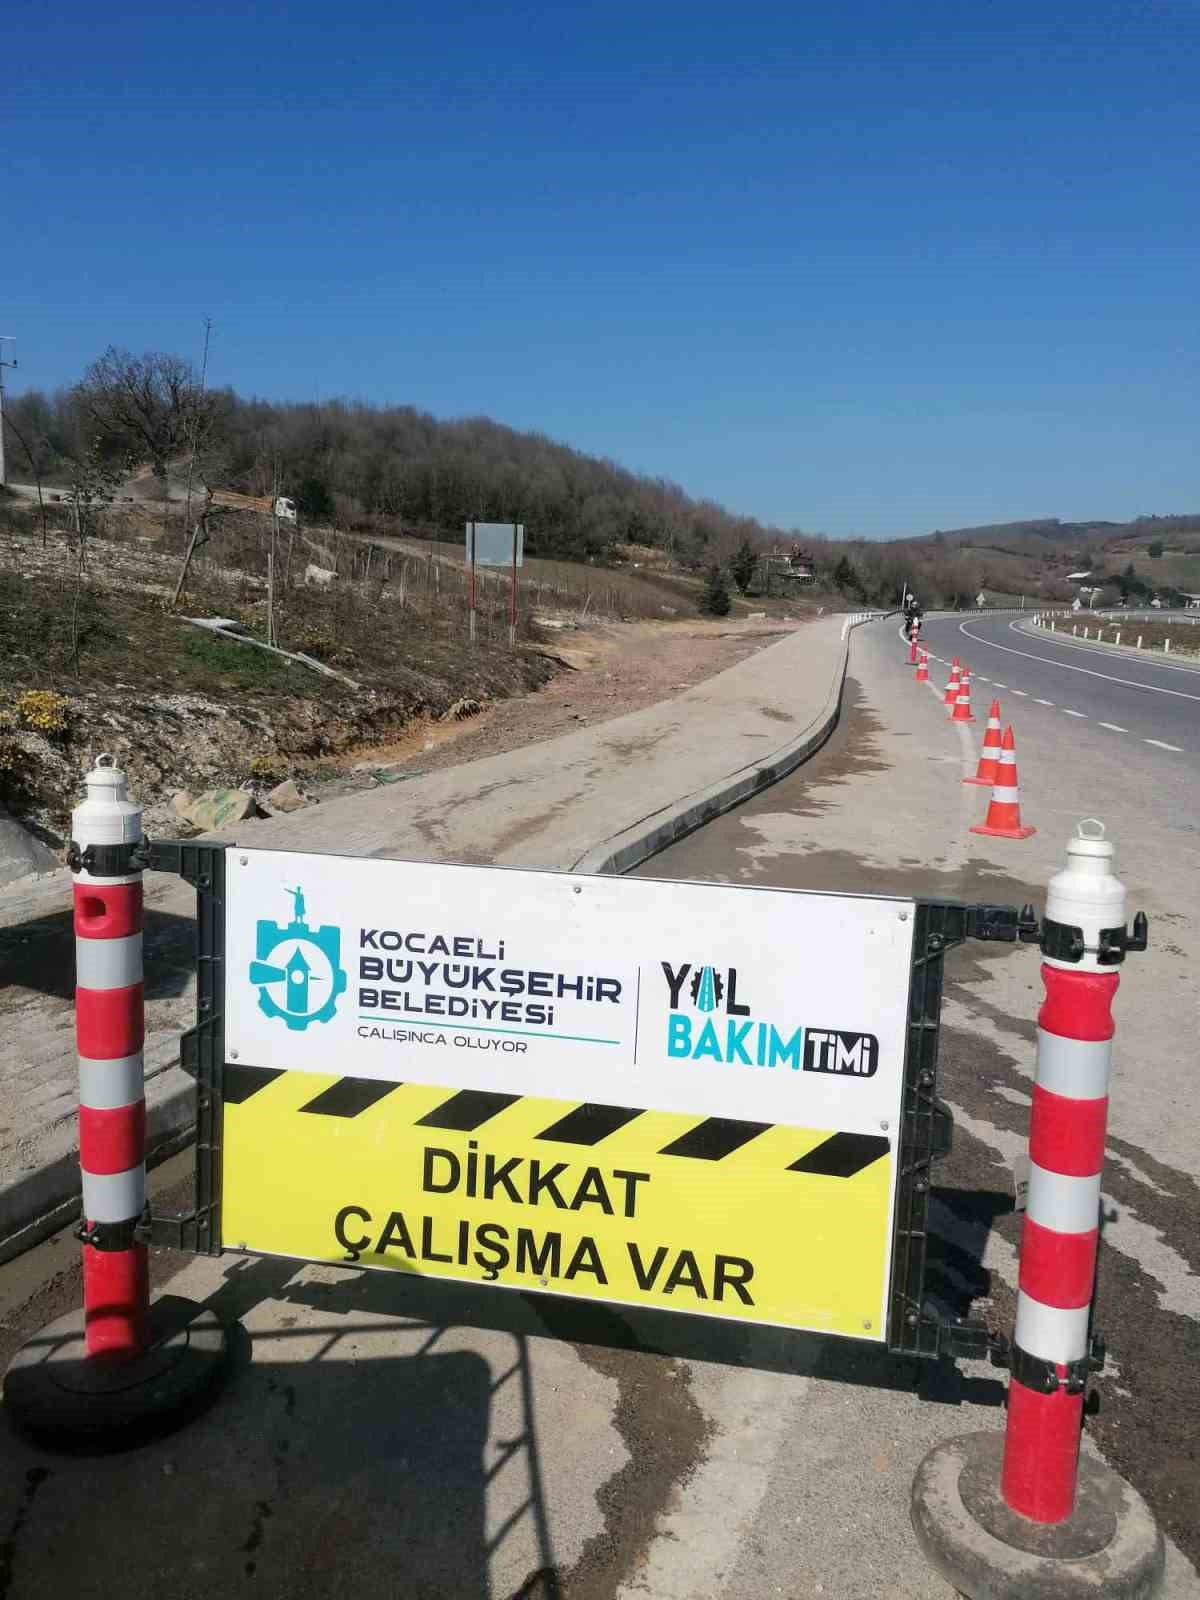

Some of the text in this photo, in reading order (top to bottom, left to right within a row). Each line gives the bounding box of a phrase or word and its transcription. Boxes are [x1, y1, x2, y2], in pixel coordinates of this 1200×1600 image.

[454, 1035, 528, 1054] OLUYOR
[667, 1013, 802, 1071] BAKIM
[422, 1140, 650, 1218] DİKKAT
[334, 1205, 756, 1306] ÇALIŞMA VAR
